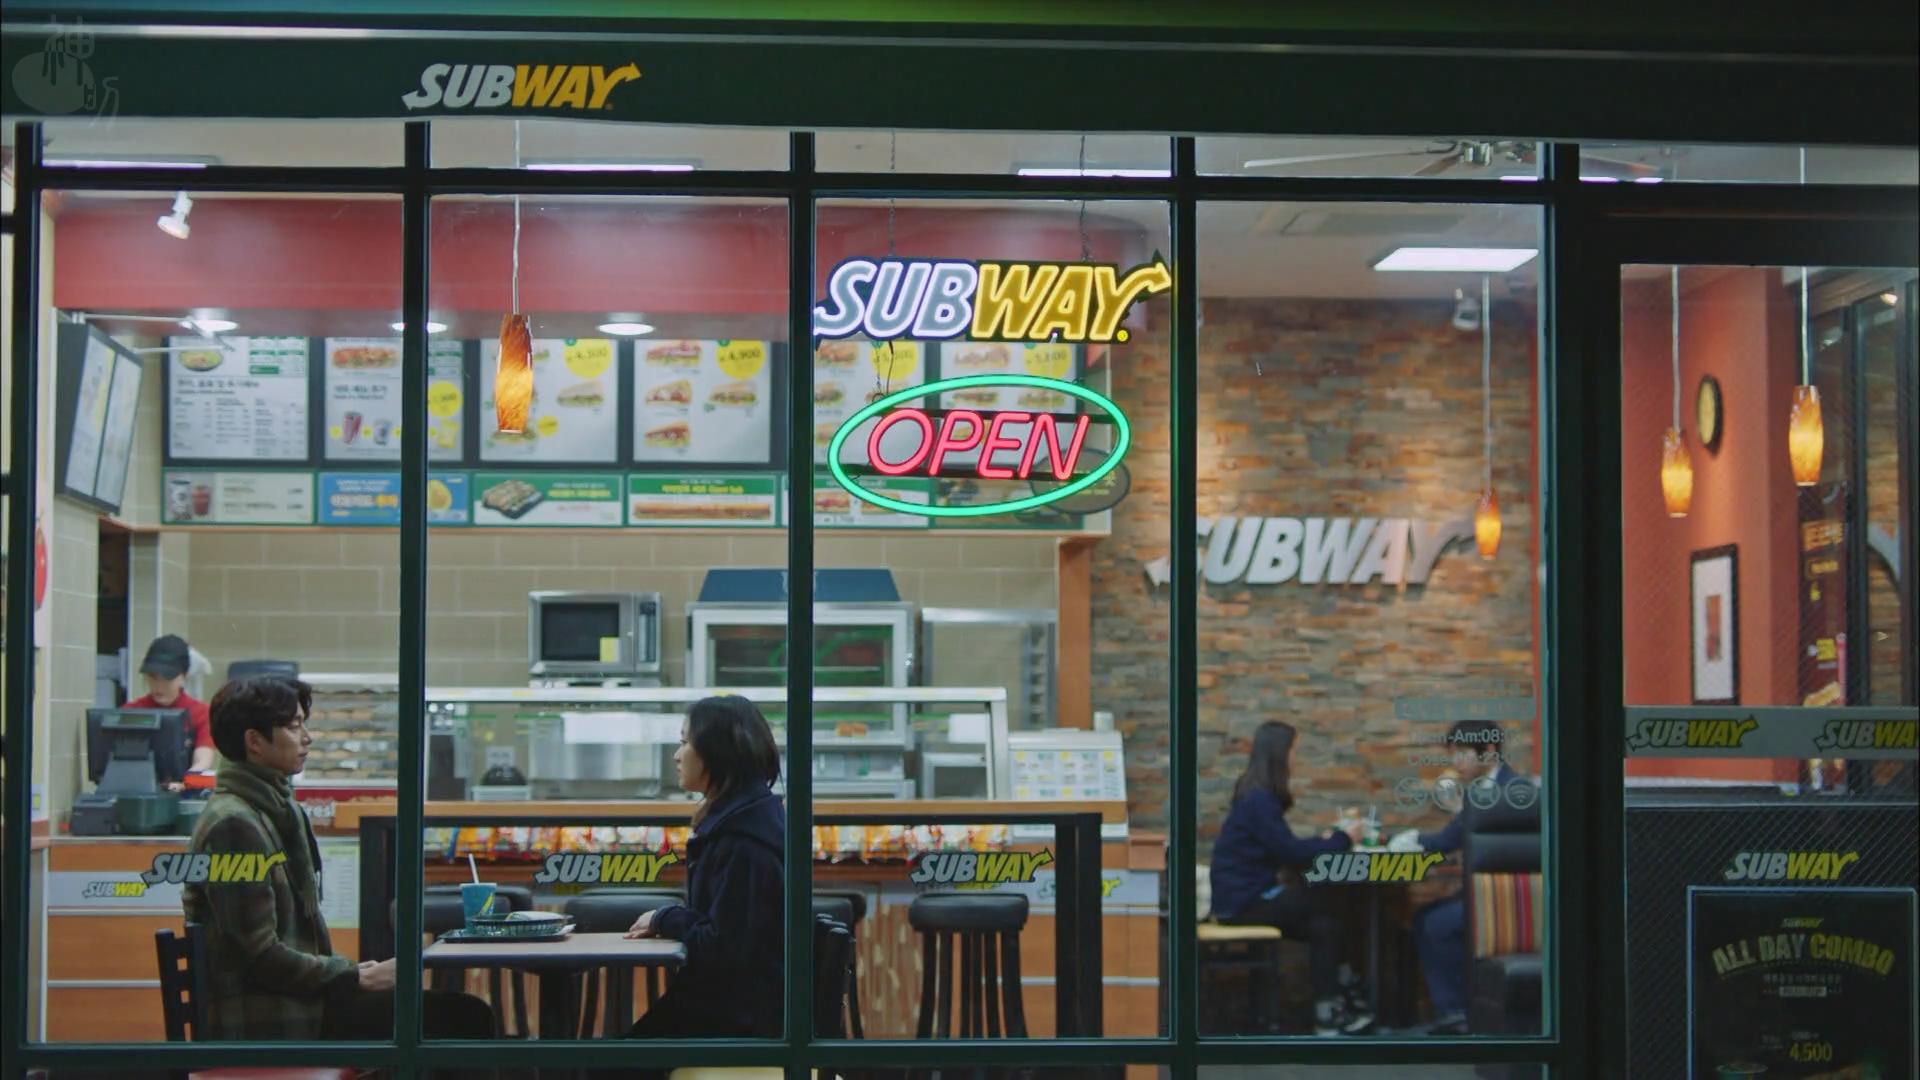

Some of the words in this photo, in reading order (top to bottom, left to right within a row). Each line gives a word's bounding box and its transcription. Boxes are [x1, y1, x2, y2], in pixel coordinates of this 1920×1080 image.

[401, 62, 641, 111] SUBWAY
[868, 408, 1090, 481] OPEN
[1625, 716, 1759, 752] SUBWAY
[1814, 719, 1917, 753] SUBWA
[141, 850, 287, 888] SUBWAY
[535, 849, 679, 886] SUBWAY
[911, 848, 1055, 887] SUBWAY
[1304, 850, 1445, 884] SUBWAY
[1724, 850, 1859, 881] SUBWAY
[83, 880, 146, 899] SUBWAY
[1711, 939, 1757, 975] ALL
[1758, 933, 1806, 963] DAY
[1809, 932, 1896, 976] COMBO
